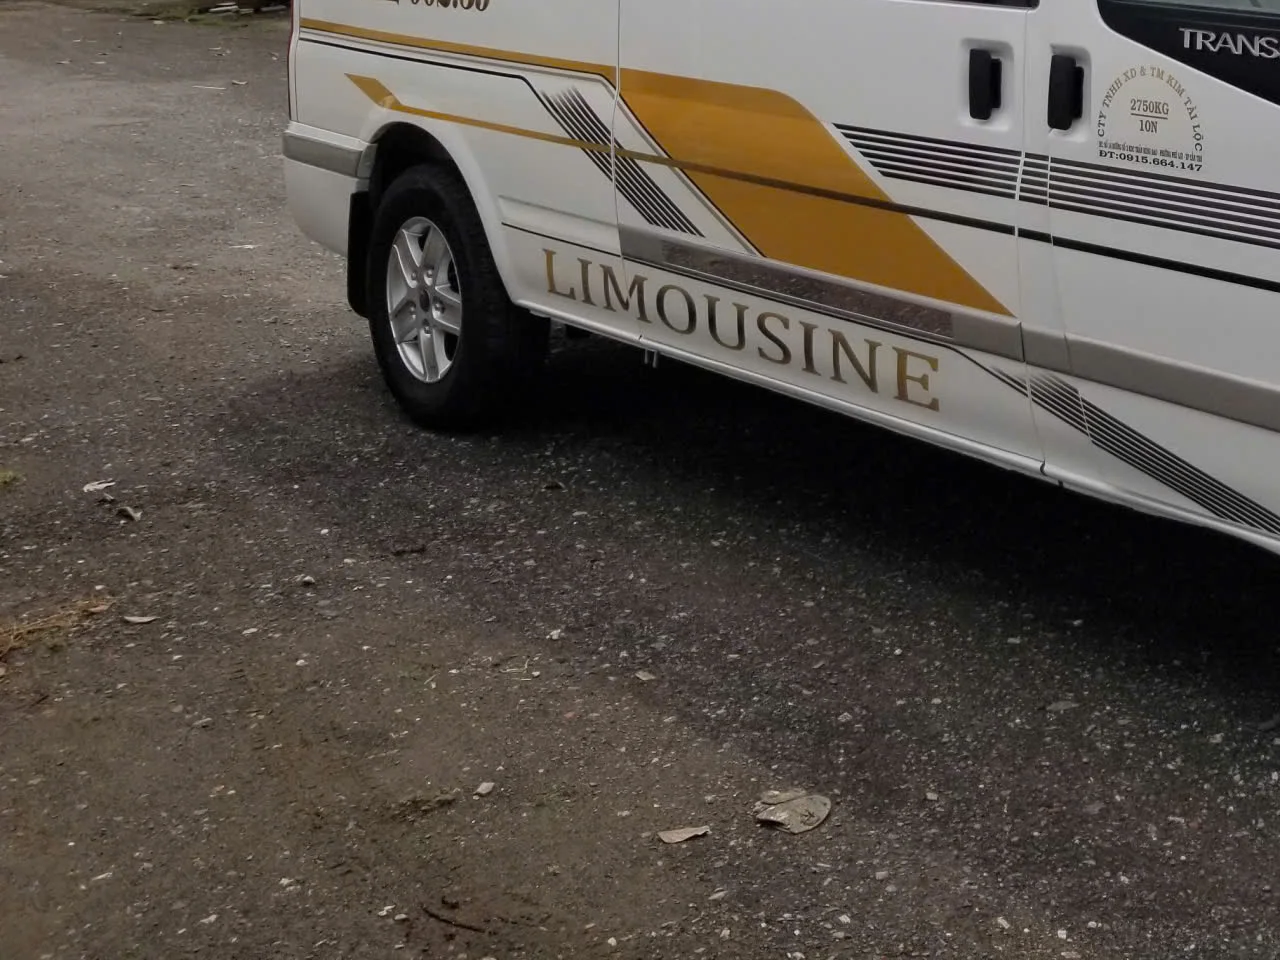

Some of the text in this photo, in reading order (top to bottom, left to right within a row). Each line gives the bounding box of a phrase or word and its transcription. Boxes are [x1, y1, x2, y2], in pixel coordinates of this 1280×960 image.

[1097, 110, 1107, 138] CTY
[1102, 77, 1124, 109] TNHH
[1139, 66, 1147, 77] &
[1150, 66, 1166, 81] TM
[1166, 75, 1186, 98] KIM
[1130, 98, 1170, 116] 2750KG
[1139, 119, 1159, 134] 10N
[1099, 149, 1203, 172] ĐT:0915.664.147
[541, 247, 941, 413] LIMOUSINE
